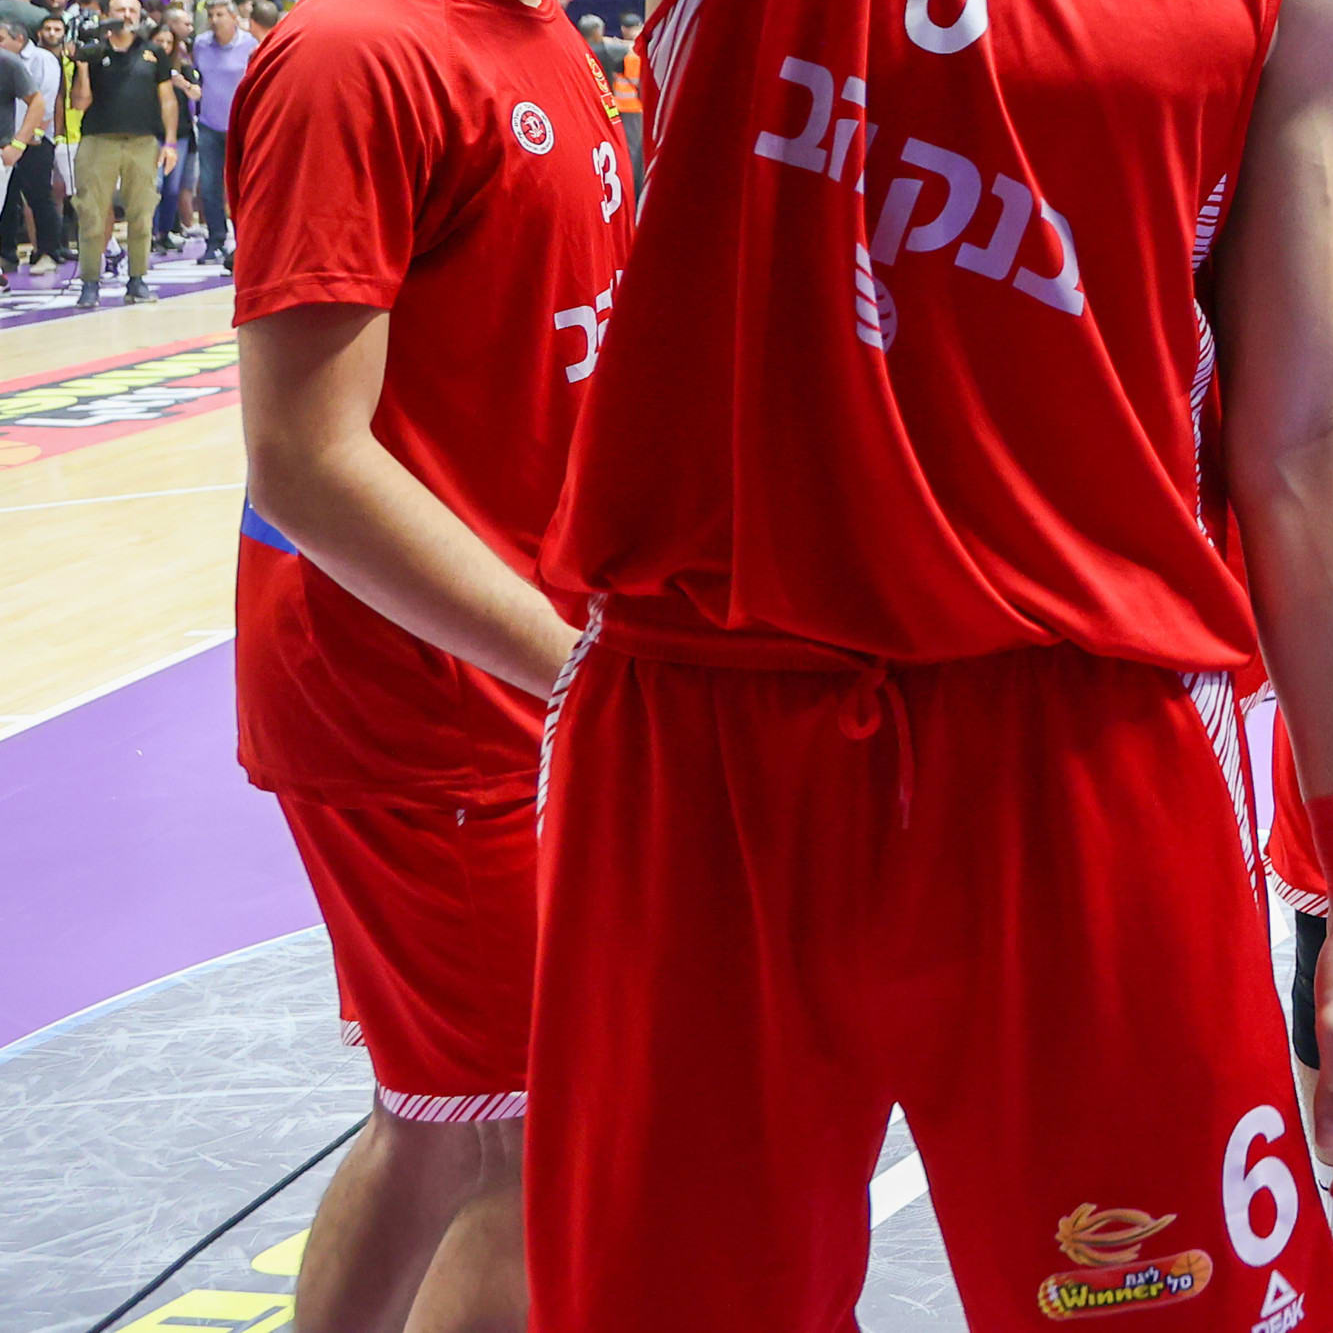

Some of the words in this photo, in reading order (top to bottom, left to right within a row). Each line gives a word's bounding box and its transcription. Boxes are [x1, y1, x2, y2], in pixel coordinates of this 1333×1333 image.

[871, 137, 1085, 317] בנק
[1222, 1104, 1299, 1268] 6
[1057, 1278, 1165, 1311] Winner
[1167, 1272, 1194, 1294] סל
